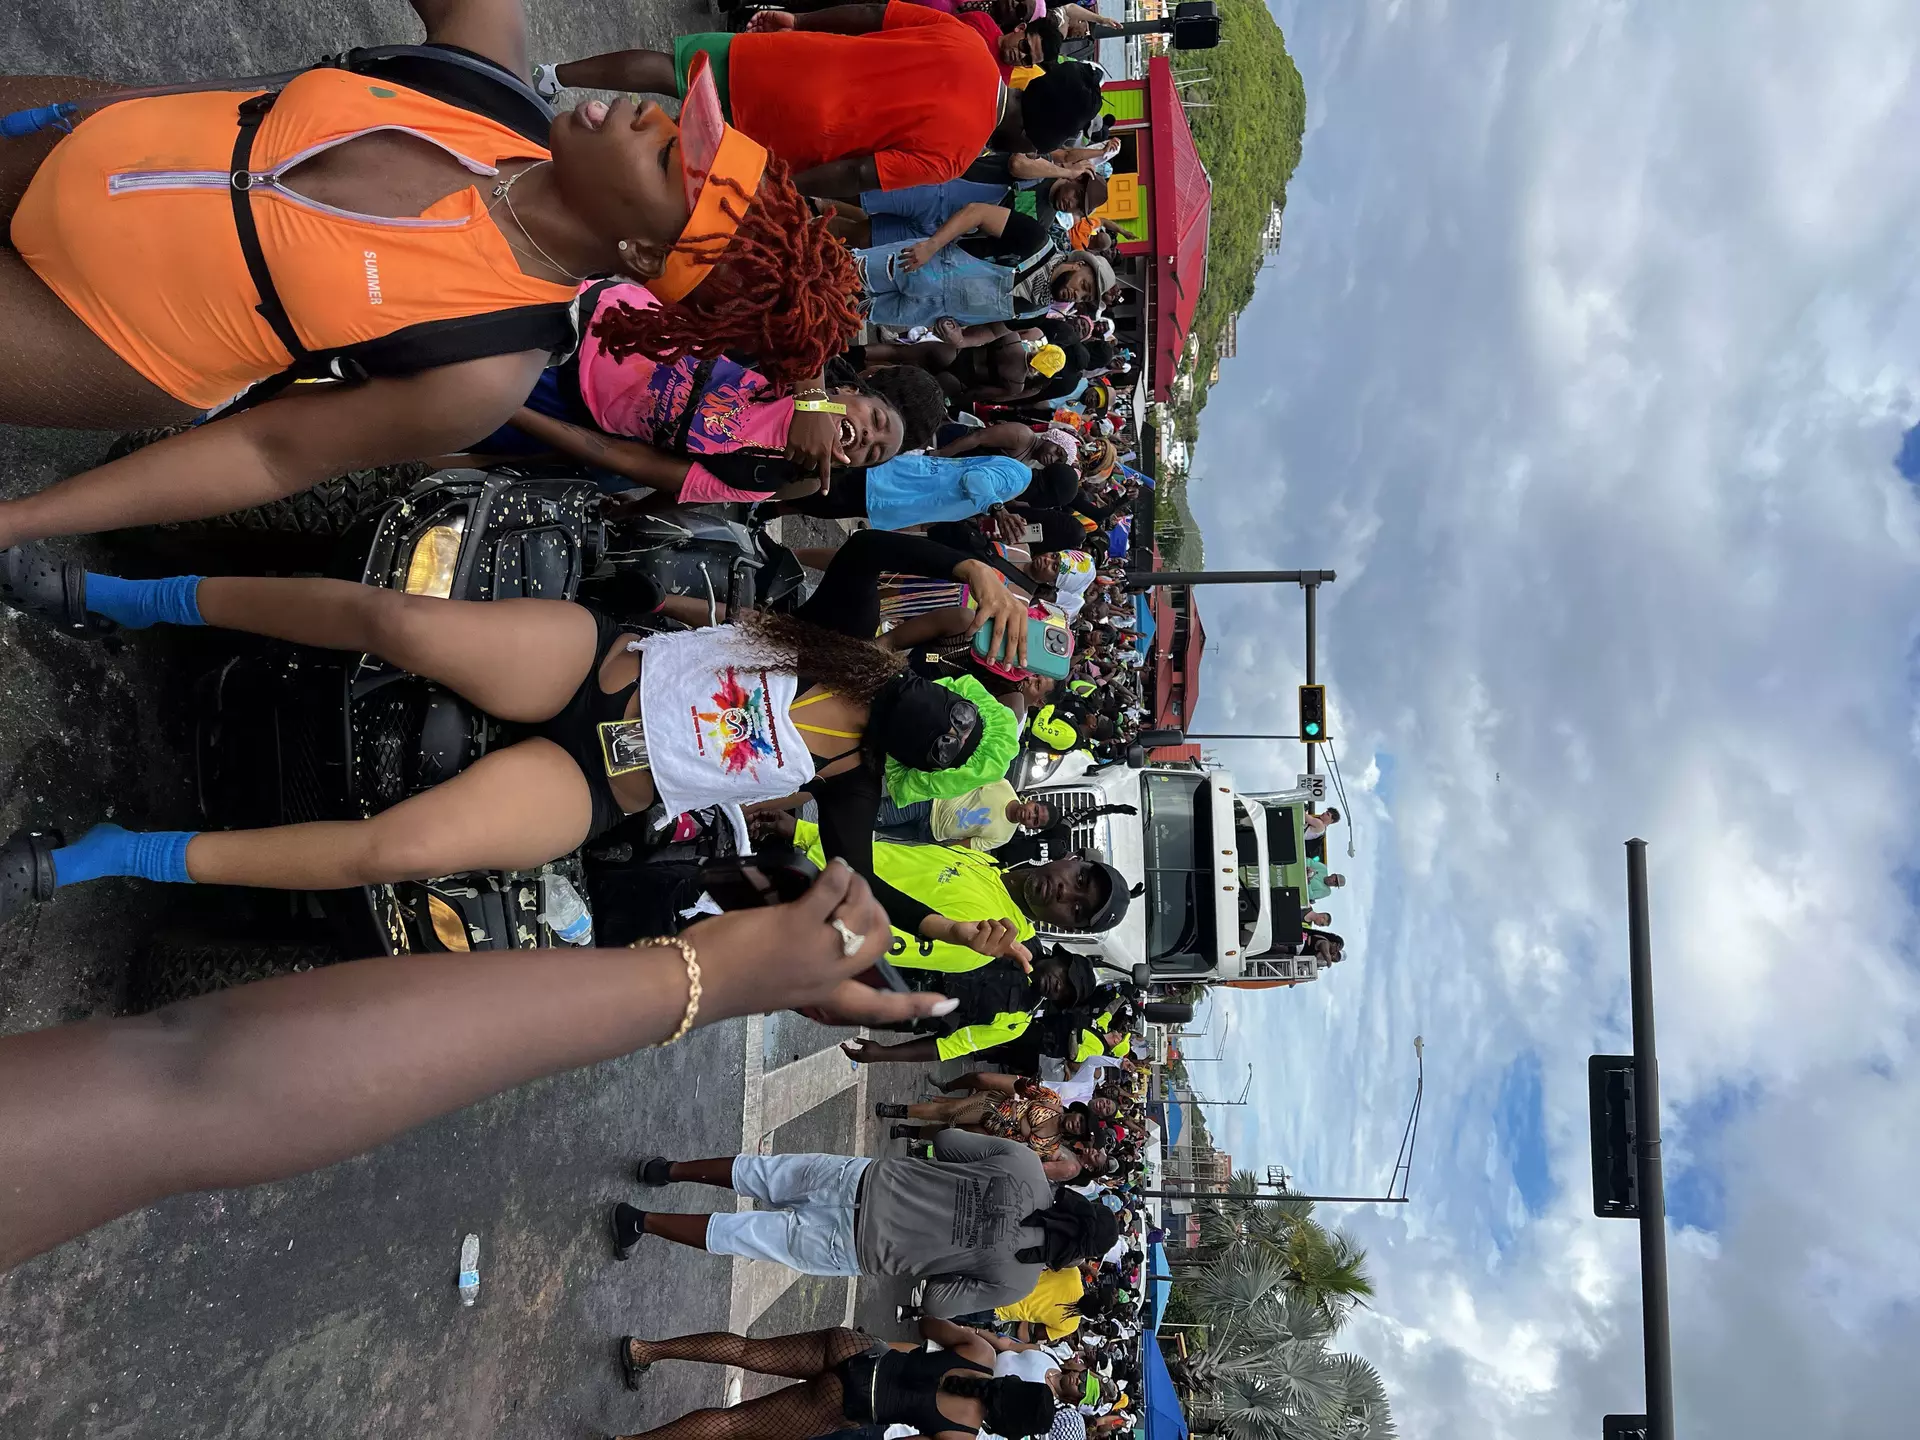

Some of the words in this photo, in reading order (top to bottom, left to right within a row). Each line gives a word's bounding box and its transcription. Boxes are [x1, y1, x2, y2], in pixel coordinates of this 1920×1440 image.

[364, 251, 382, 305] SUMMER
[659, 370, 677, 410] J'OUVERT
[1312, 779, 1323, 796] NO
